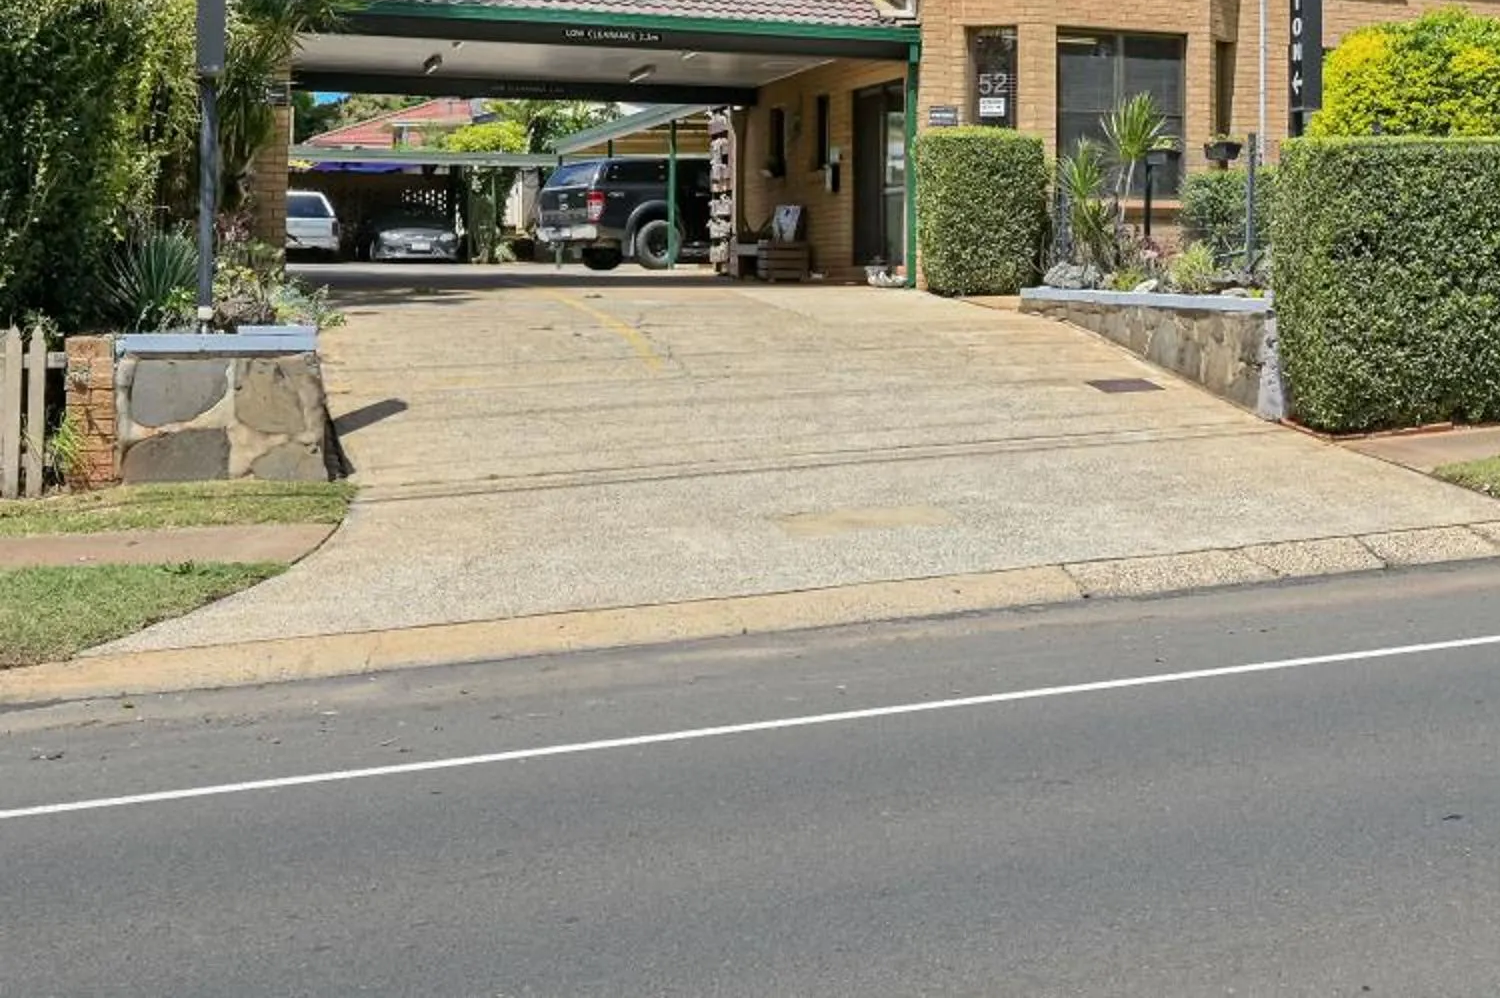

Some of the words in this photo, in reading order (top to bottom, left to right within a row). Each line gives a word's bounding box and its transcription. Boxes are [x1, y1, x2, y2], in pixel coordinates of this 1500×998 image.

[565, 29, 584, 37] LOW
[587, 30, 636, 41] CLEARANCE
[979, 73, 1008, 94] 52
